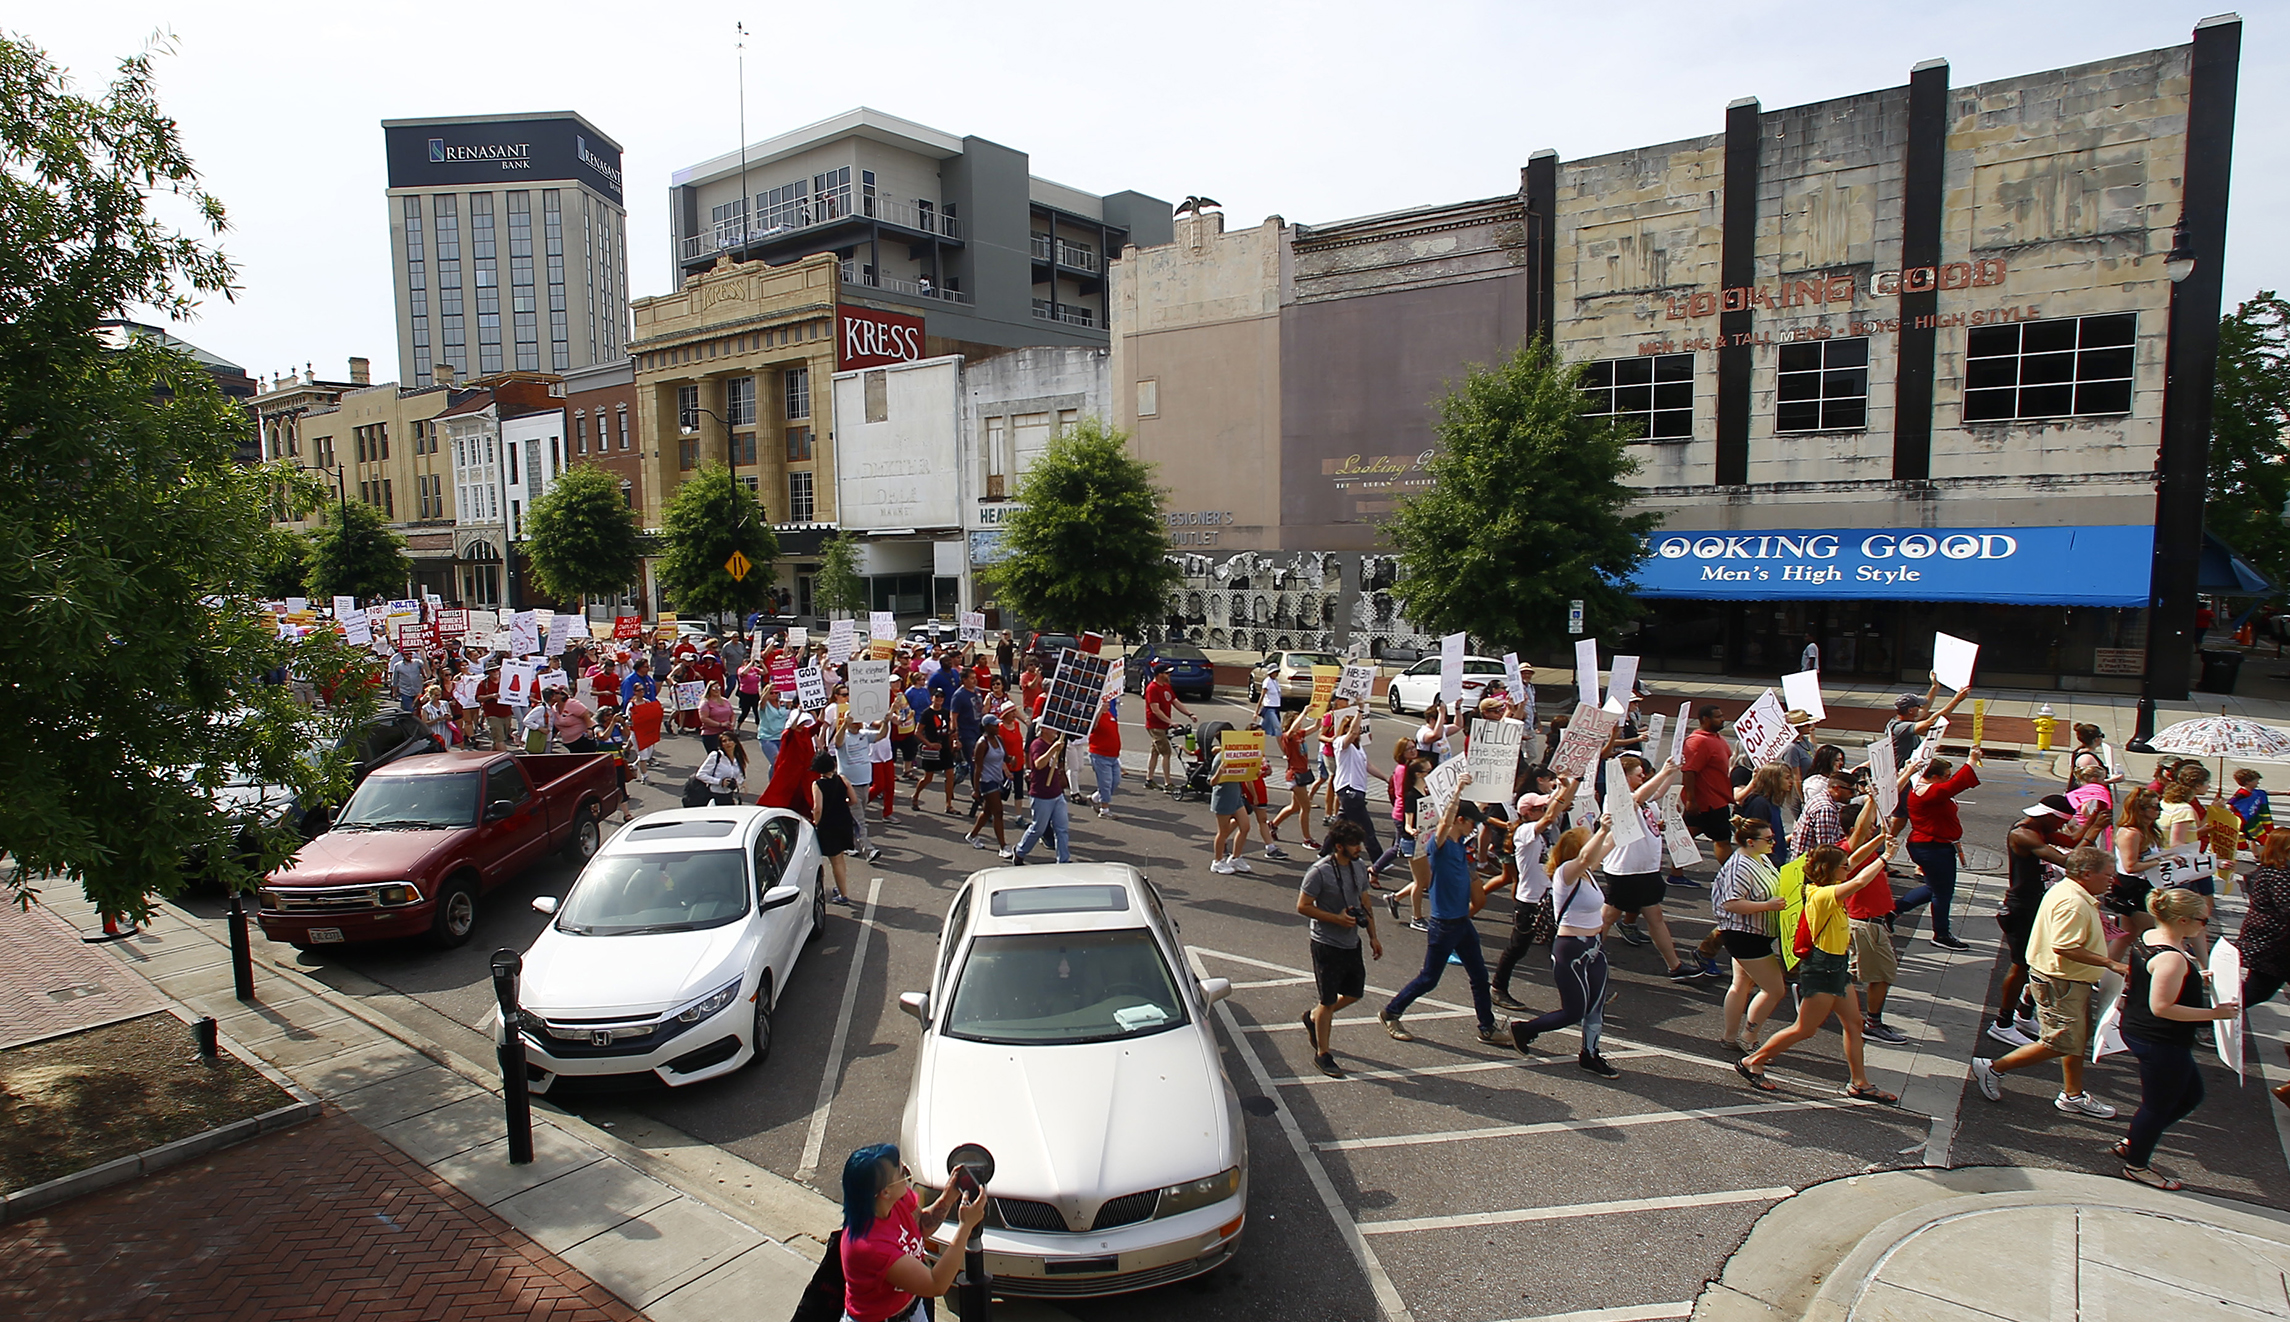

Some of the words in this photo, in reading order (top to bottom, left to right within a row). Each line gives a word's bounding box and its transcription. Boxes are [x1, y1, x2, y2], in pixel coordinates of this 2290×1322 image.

[446, 144, 530, 159] RENASANT
[502, 160, 530, 170] BANK
[585, 149, 621, 183] RENASANT
[609, 181, 622, 194] BANK
[703, 280, 746, 311] KRESS
[1665, 276, 1854, 320] LOOKING
[1870, 258, 2007, 299] GOOD
[1732, 331, 1774, 346] TALL
[1780, 325, 1832, 342] MENS
[1851, 319, 1900, 336] BOYS
[1915, 312, 1965, 329] HIGH
[1971, 304, 2041, 326] STYLE
[843, 316, 919, 362] KRESS
[1335, 454, 1411, 481] Looking
[1164, 511, 1234, 527] DESIGNER'S
[1171, 530, 1219, 546] OUTLET
[1861, 534, 2017, 559] GOOD
[1701, 565, 1770, 582] Men's
[1781, 565, 1843, 584] High
[1856, 565, 1921, 583] Style
[391, 600, 418, 610] NOLITE
[438, 610, 461, 618] PROTECT
[623, 616, 639, 624] NOT
[798, 668, 817, 678] GOD
[1346, 667, 1359, 677] HB
[1350, 680, 1359, 688] IS
[805, 689, 820, 697] PLAN
[802, 697, 828, 710] RAPE
[1736, 710, 1758, 739] Not
[1750, 724, 1770, 753] Our
[1752, 724, 1794, 769] Daughters!
[1470, 746, 1489, 757] the
[1491, 747, 1512, 758] state
[1429, 772, 1447, 798] WE
[2159, 862, 2175, 887] NOT
